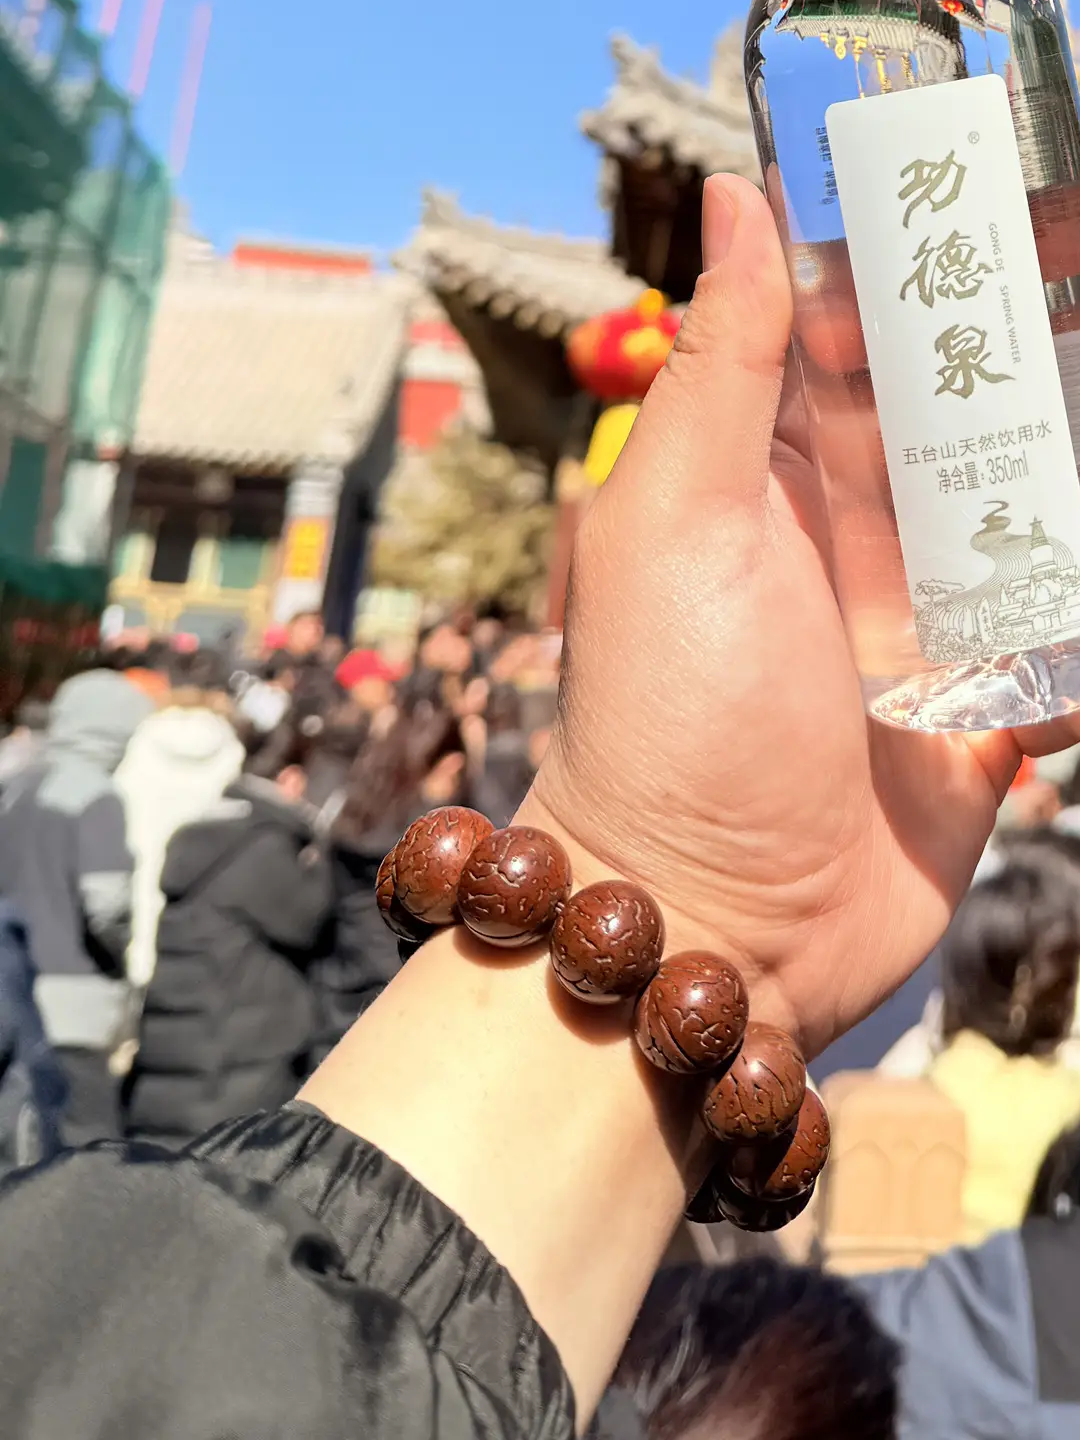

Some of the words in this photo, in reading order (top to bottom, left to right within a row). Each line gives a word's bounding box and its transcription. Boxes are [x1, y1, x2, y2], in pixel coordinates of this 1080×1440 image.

[987, 222, 1002, 256] GONG
[898, 149, 1016, 399] 功德泉
[994, 258, 1005, 273] DE
[999, 285, 1015, 325] SPRING
[1007, 326, 1022, 365] WATER
[902, 419, 1053, 466] 五台山天然饮用水
